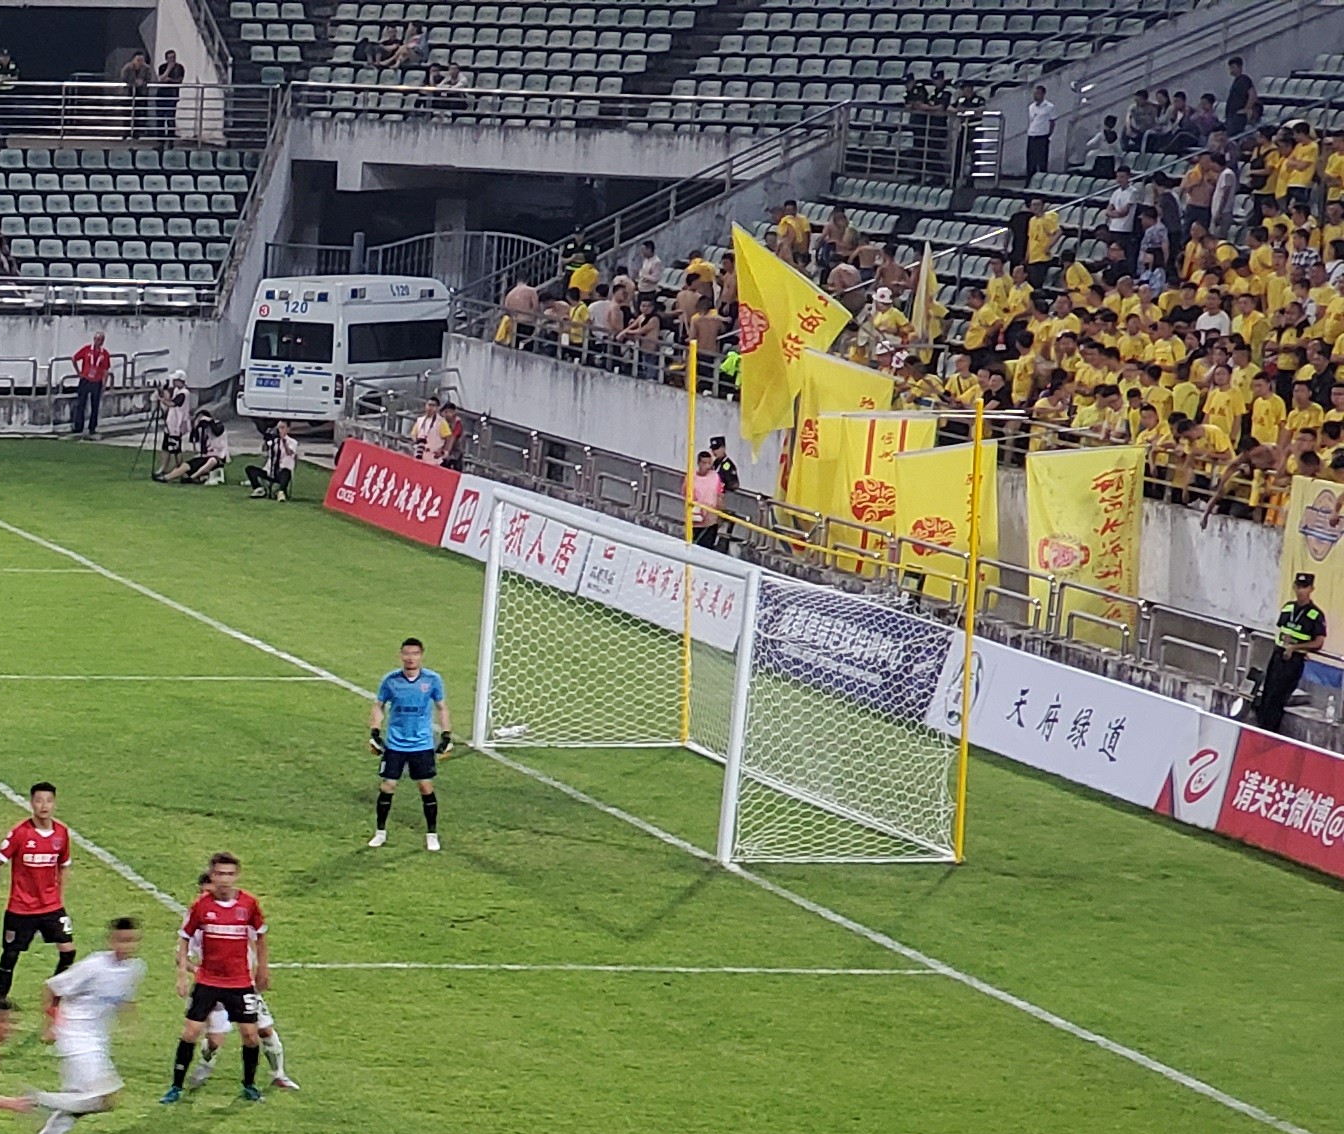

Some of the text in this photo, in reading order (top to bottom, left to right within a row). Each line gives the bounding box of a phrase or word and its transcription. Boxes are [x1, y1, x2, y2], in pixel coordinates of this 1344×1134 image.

[395, 285, 410, 296] 120
[284, 301, 309, 314] 120
[1006, 687, 1129, 763] 天府绿道
